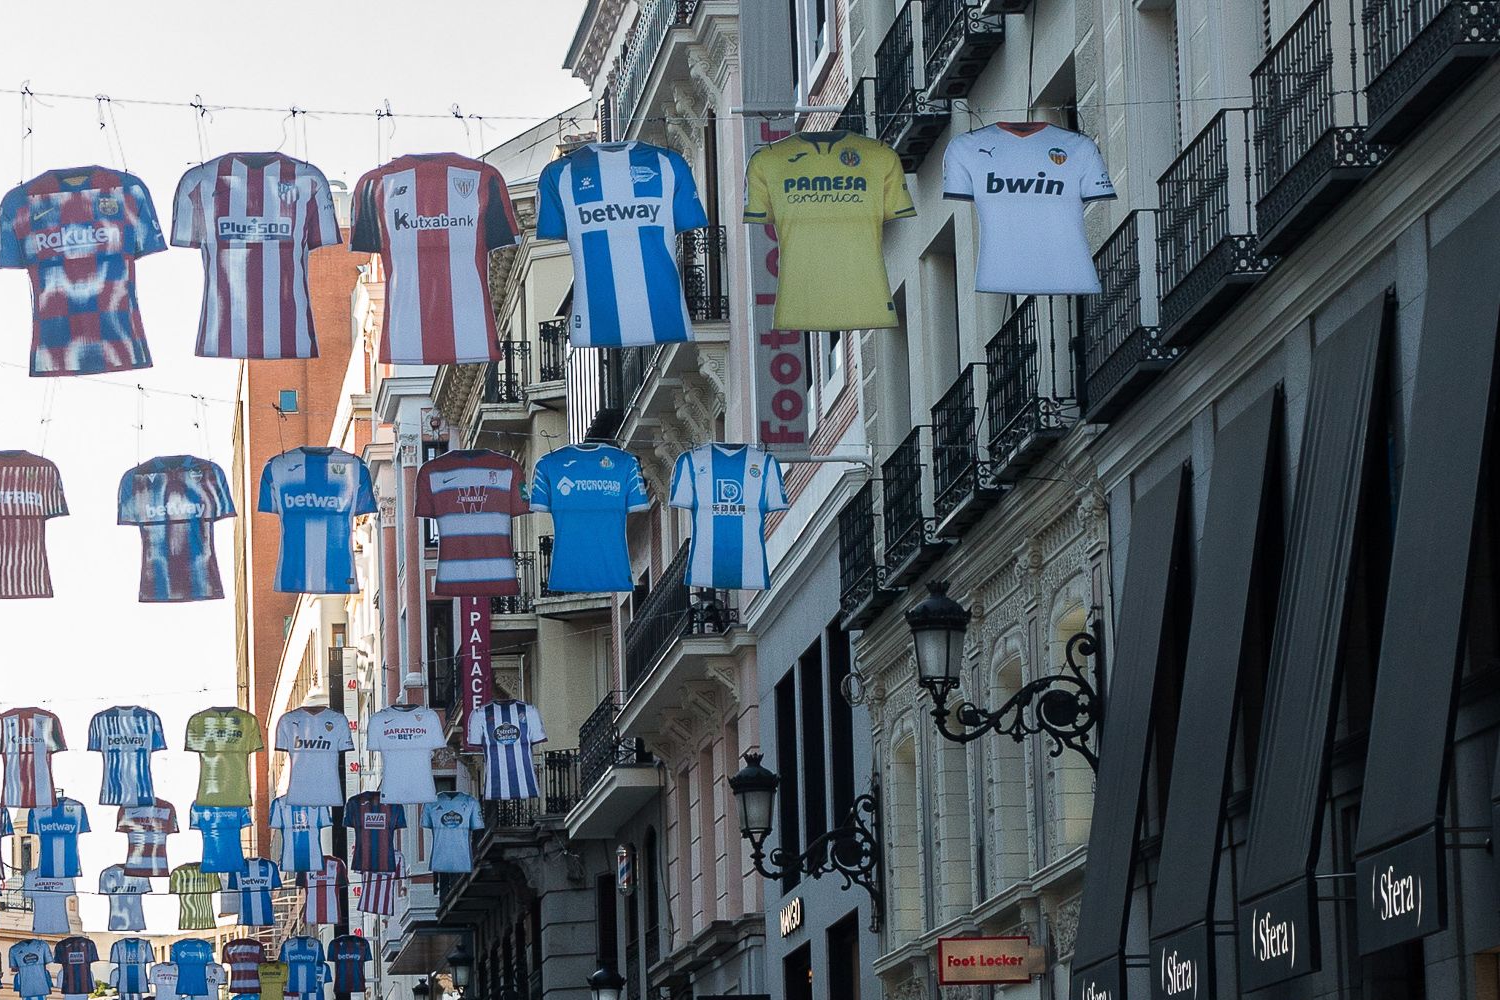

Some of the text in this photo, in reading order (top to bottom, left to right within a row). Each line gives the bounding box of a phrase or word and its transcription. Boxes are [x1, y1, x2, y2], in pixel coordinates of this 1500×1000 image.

[783, 175, 867, 193] PAMESA
[986, 172, 1065, 195] bwin
[393, 208, 474, 231] Kutxabank
[577, 202, 661, 225] betway
[219, 221, 290, 235] Plus500
[36, 224, 121, 249] Rakuten
[760, 330, 804, 444] Foot
[575, 479, 621, 493] TECNOCASA
[145, 501, 206, 518] betway
[284, 492, 349, 512] betway
[383, 727, 427, 736] MARATHON
[397, 733, 413, 741] BET
[107, 735, 148, 747] betway
[293, 735, 332, 750] bwin
[40, 822, 76, 834] betway
[241, 878, 268, 887] betway
[779, 897, 801, 938] MANGO
[946, 953, 1024, 968] Foot Locker
